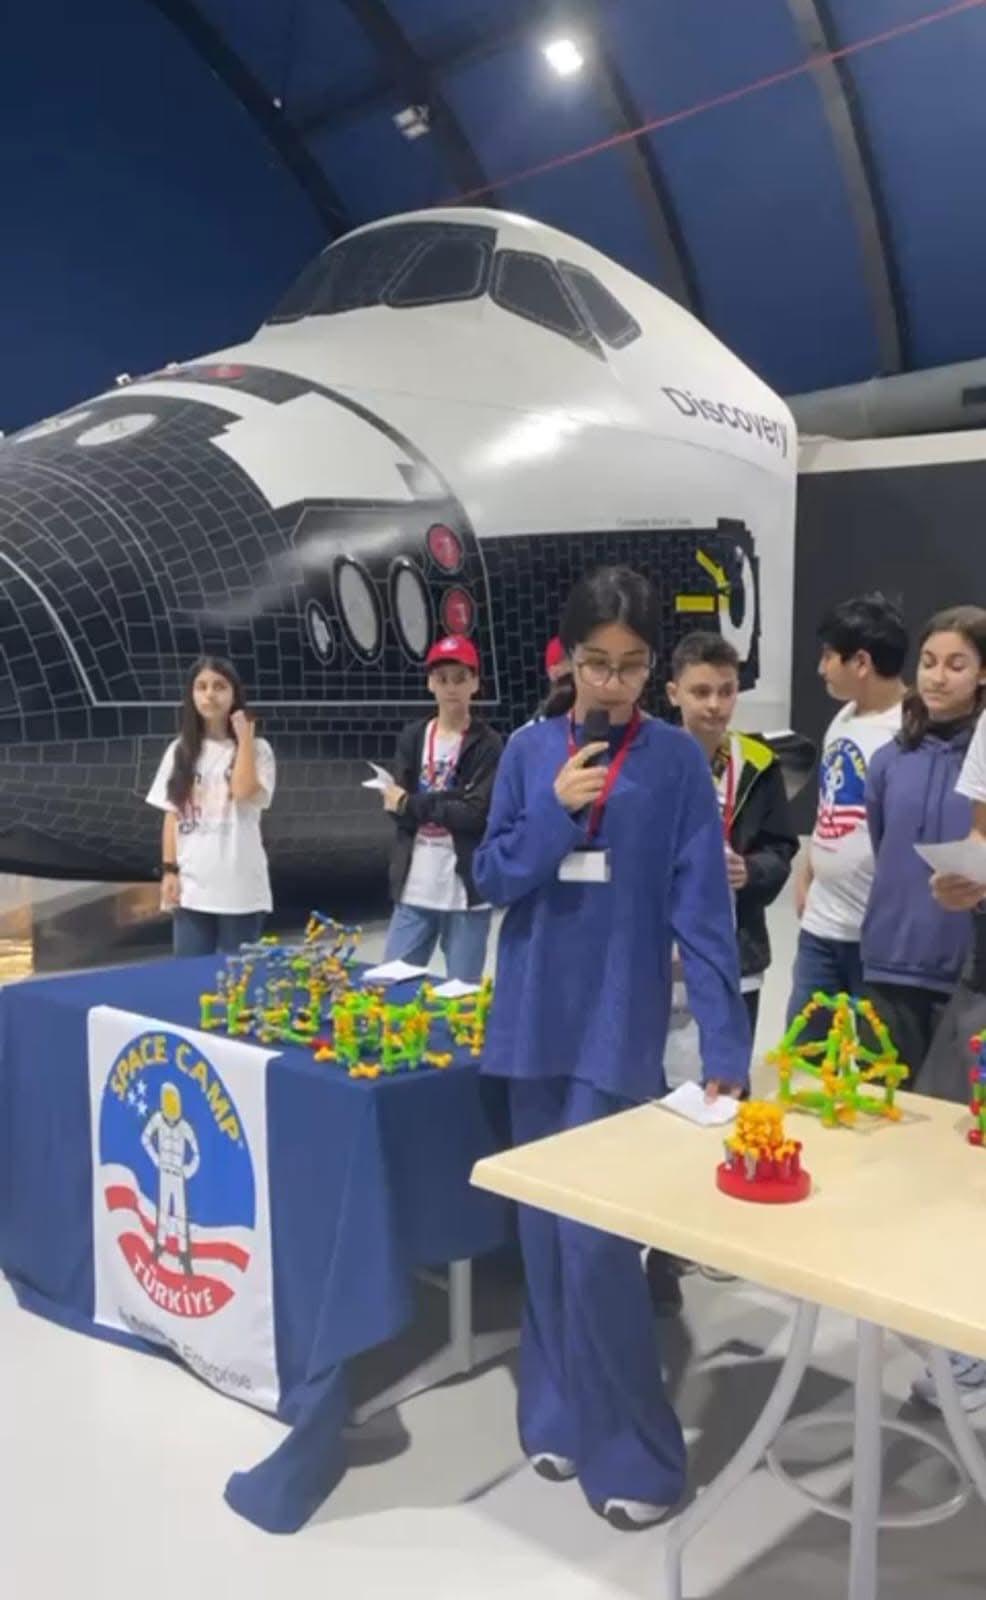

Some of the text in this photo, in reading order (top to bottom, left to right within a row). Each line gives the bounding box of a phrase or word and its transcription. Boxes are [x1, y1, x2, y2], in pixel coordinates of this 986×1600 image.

[660, 386, 788, 458] Discovery
[111, 1035, 241, 1142] SPACE CAMP
[133, 1254, 215, 1315] TÜRKİYE
